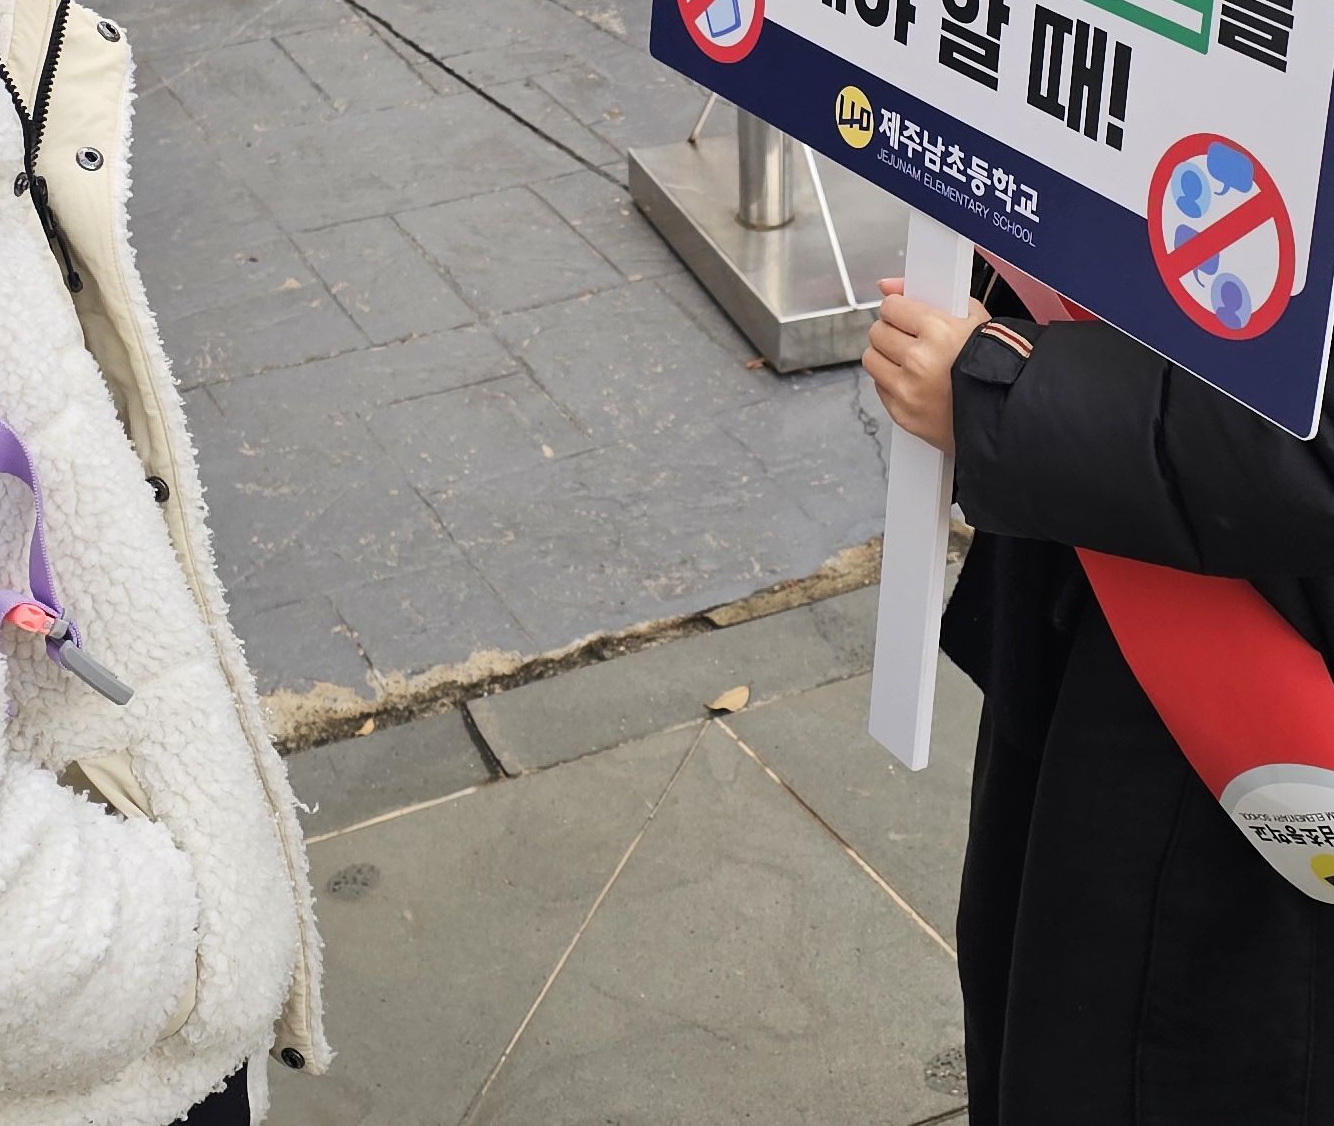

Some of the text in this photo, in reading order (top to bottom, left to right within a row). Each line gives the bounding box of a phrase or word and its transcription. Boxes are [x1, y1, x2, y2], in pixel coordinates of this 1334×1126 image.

[1027, 3, 1133, 152] 때!
[876, 147, 1037, 248] JEJUNAM ELEMENTARY SCHOOL
[878, 107, 1040, 223] 제주남초등학교
[1238, 812, 1272, 822] SCHOOL
[1272, 811, 1326, 823] ELEMENTARY
